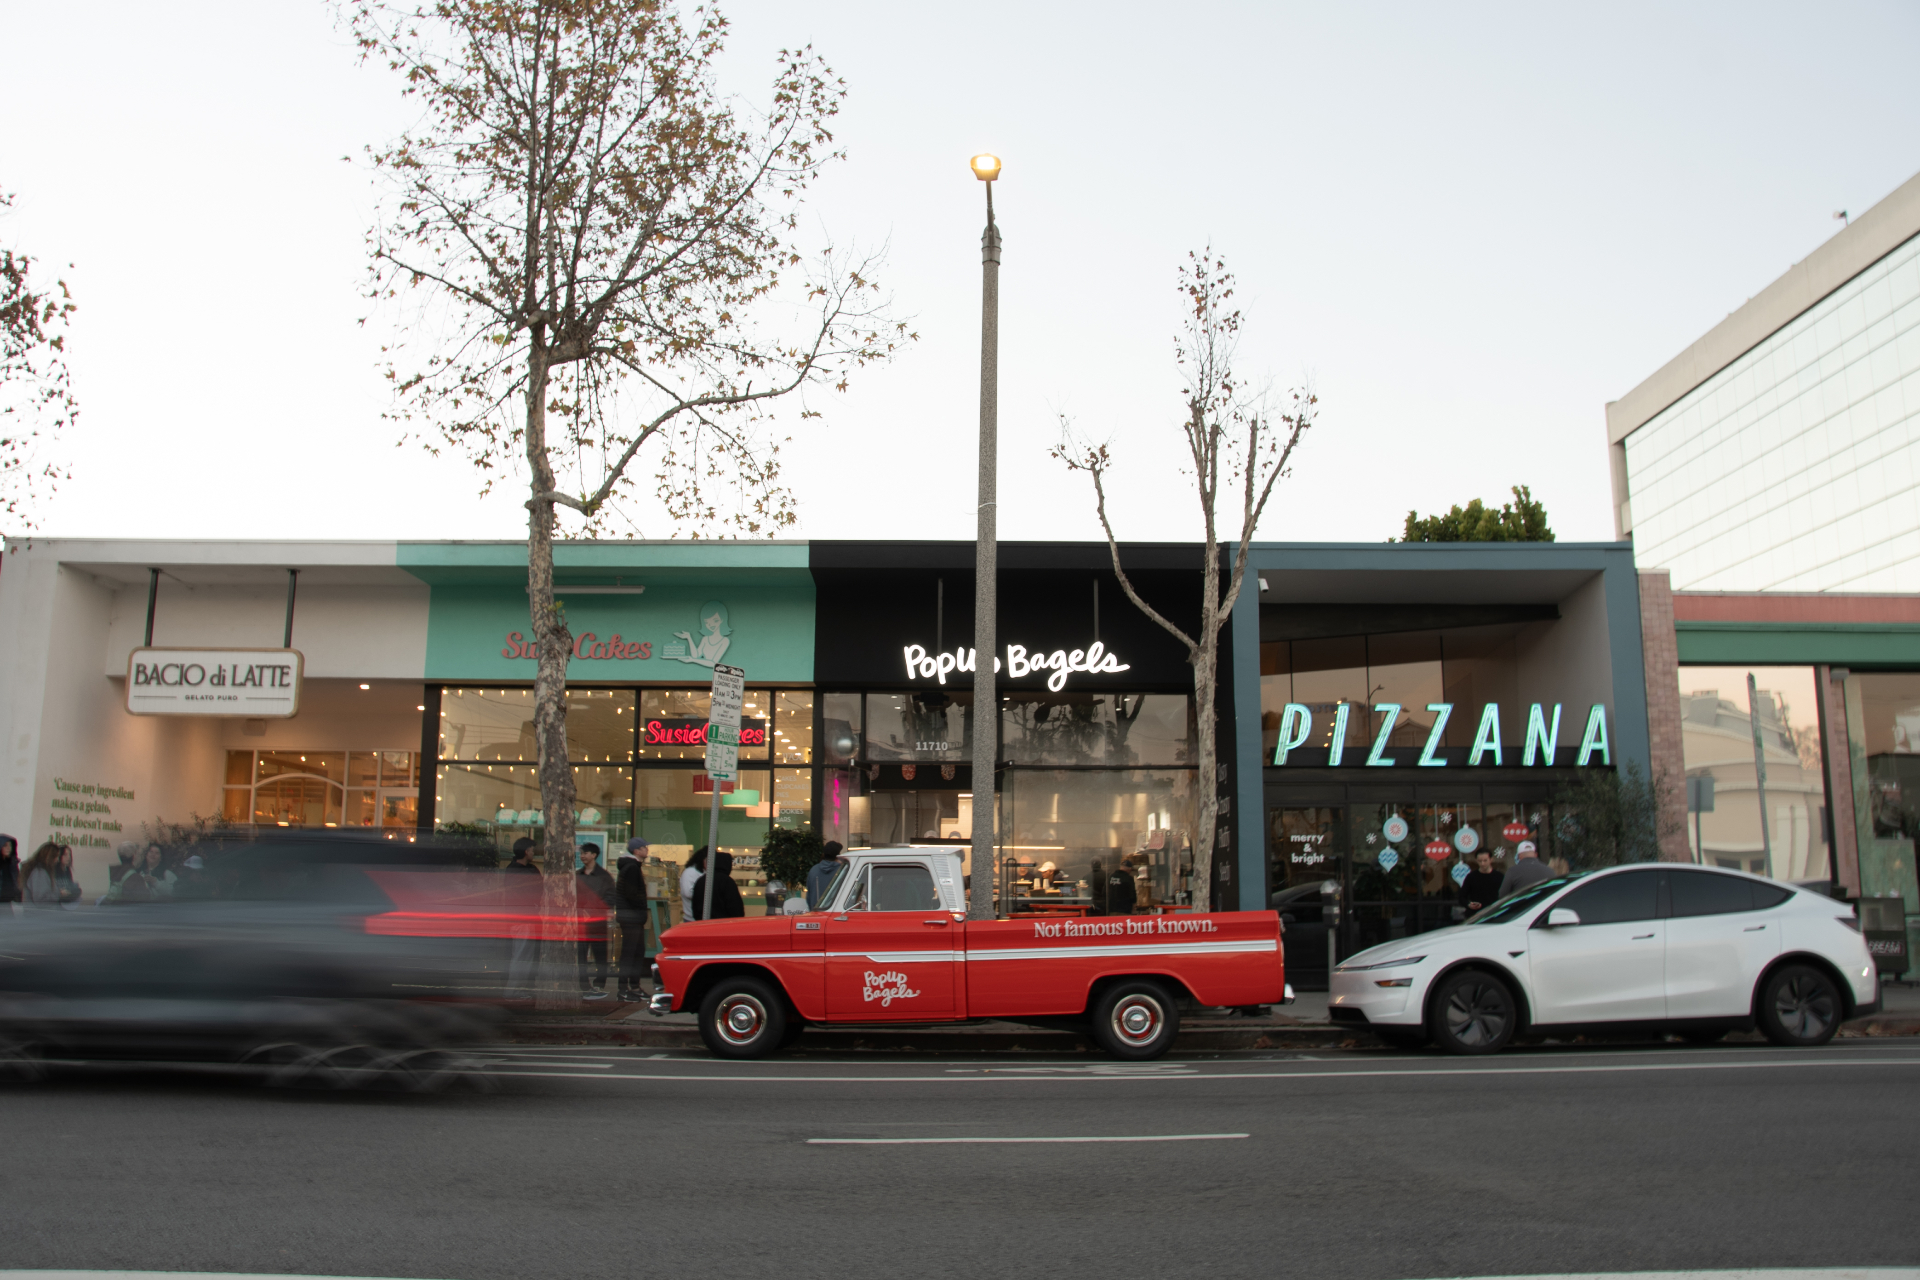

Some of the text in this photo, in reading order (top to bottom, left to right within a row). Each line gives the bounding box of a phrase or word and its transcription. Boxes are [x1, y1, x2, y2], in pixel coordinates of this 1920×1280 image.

[502, 631, 652, 660] SuCakes
[134, 663, 291, 687] BACIO di LATTE
[904, 641, 1130, 692] PopU Bagels
[719, 731, 738, 743] PARKING
[1274, 703, 1610, 766] PIZZANA
[915, 741, 948, 751] 11710
[81, 784, 95, 797] any
[96, 783, 135, 800] ingredient
[51, 797, 111, 814] makes a gelato,
[49, 813, 122, 832] but it doesn't make
[54, 831, 78, 846] Bacio
[79, 834, 88, 847] di
[1290, 834, 1324, 845] merry
[1303, 843, 1312, 853] &
[1291, 852, 1325, 865] bright
[1034, 922, 1061, 938] Not
[1065, 920, 1123, 937] famous
[1126, 918, 1155, 934] but
[863, 983, 919, 1007] Bagels
